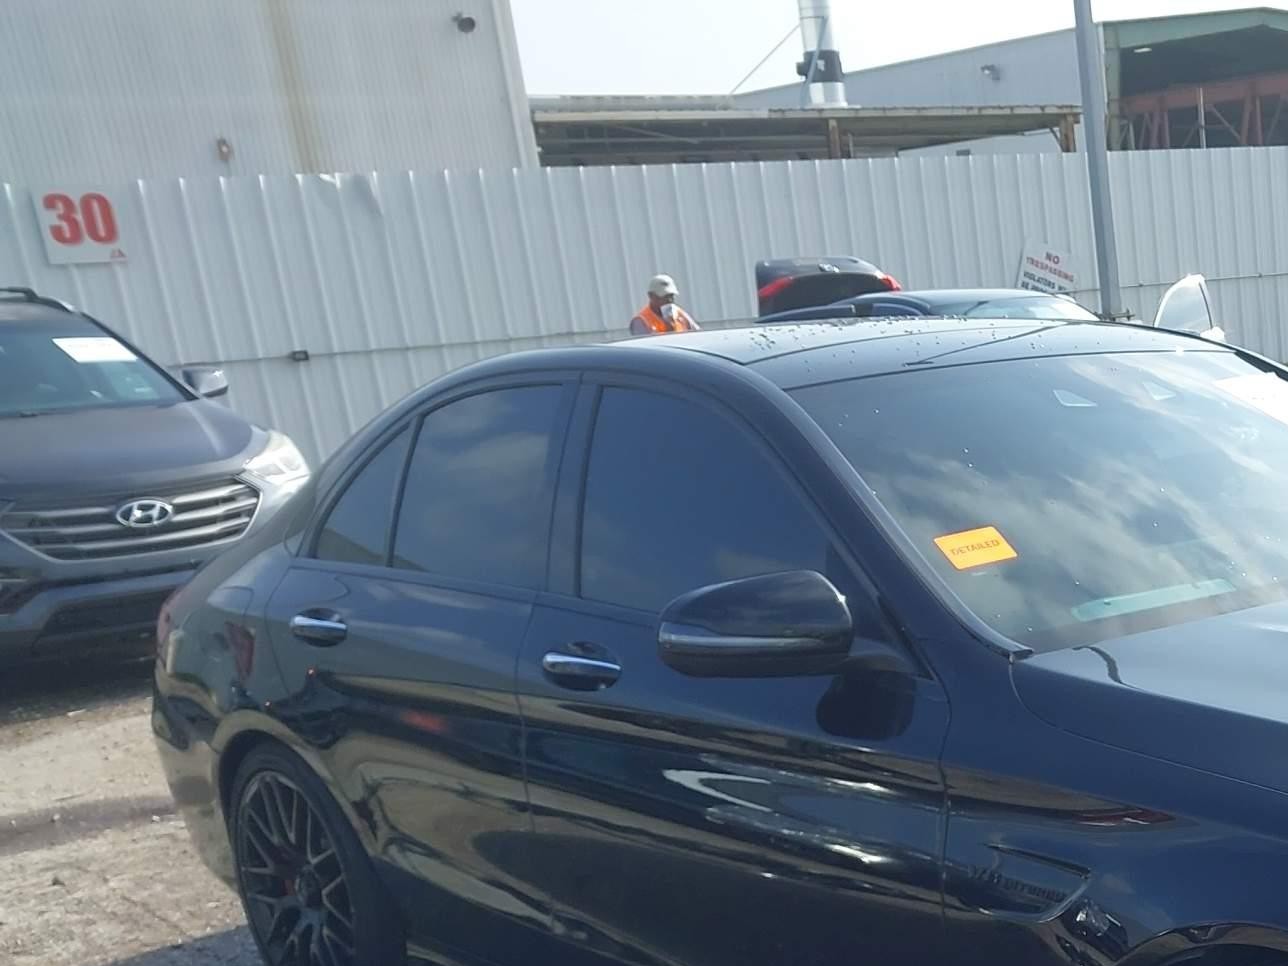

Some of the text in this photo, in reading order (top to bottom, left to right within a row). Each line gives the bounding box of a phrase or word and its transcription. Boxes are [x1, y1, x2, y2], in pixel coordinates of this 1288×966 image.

[42, 192, 119, 247] 30
[1045, 251, 1060, 265] NO
[1026, 256, 1074, 282] TRESPASSING
[950, 539, 1001, 556] DETAILED
